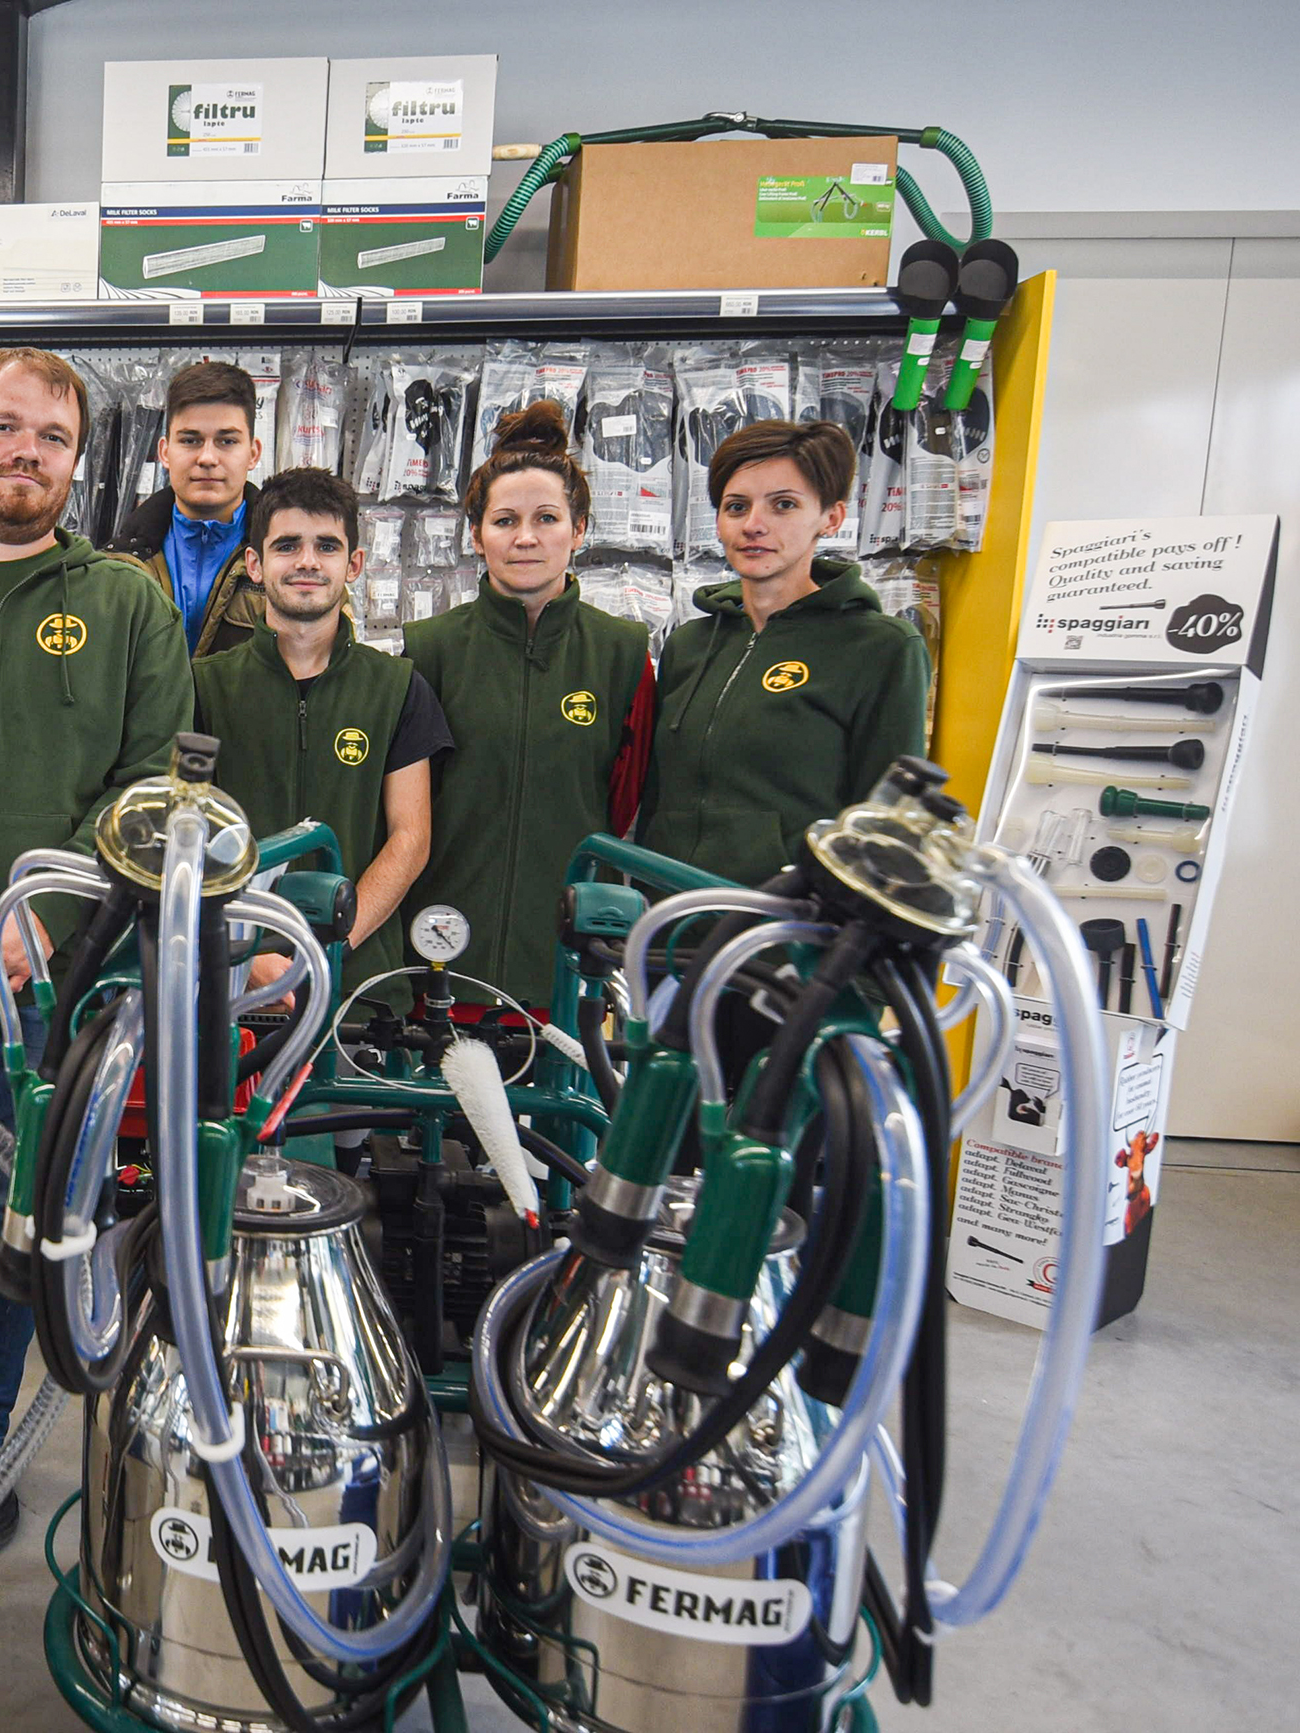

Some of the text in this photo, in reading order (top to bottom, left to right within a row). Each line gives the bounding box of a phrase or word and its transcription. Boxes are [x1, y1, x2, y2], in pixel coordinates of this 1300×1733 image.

[193, 104, 255, 119] filtru
[392, 101, 455, 116] filtru
[447, 192, 479, 200] Farma
[60, 209, 87, 217] DeLaval
[1049, 545, 1146, 574] compatible
[1151, 542, 1196, 559] pays
[1202, 536, 1233, 553] off
[1050, 529, 1152, 559] Spaggiari's
[1048, 556, 1225, 588] Quality and saving
[1046, 578, 1154, 603] guaranteed.
[1057, 615, 1150, 632] spaggiari
[1168, 612, 1242, 638] -40%
[965, 1149, 1049, 1175] adapt. Delaval
[966, 1138, 1028, 1161] Compatible
[961, 1176, 997, 1190] adapt.
[963, 1167, 1060, 1197] adapt. Gascoigne
[964, 1158, 1053, 1186] adapt. Fullwood
[960, 1185, 995, 1199] adapt.
[958, 1203, 994, 1217] adapt.
[959, 1195, 1050, 1224] adapt. Strangko
[957, 1216, 1049, 1246] and many more!
[626, 1575, 784, 1627] FERMAG
